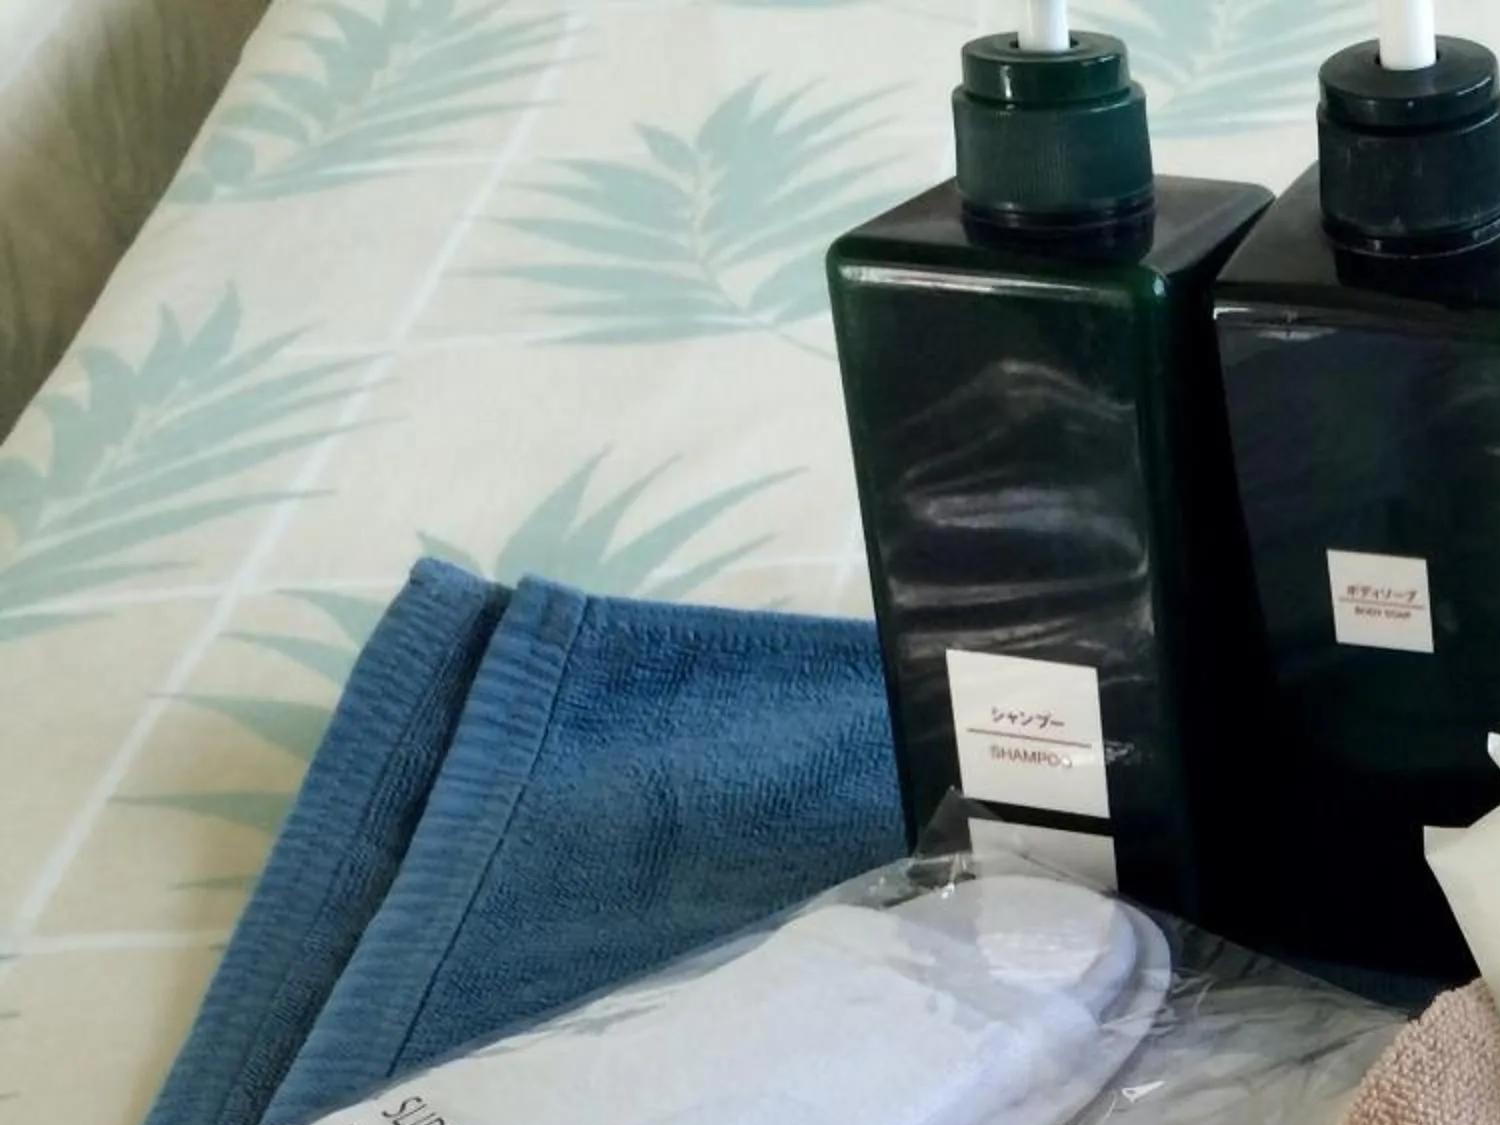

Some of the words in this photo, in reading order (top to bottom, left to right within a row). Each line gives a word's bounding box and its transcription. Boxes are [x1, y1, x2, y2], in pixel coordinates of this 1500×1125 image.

[990, 706, 1066, 729] シャンプー
